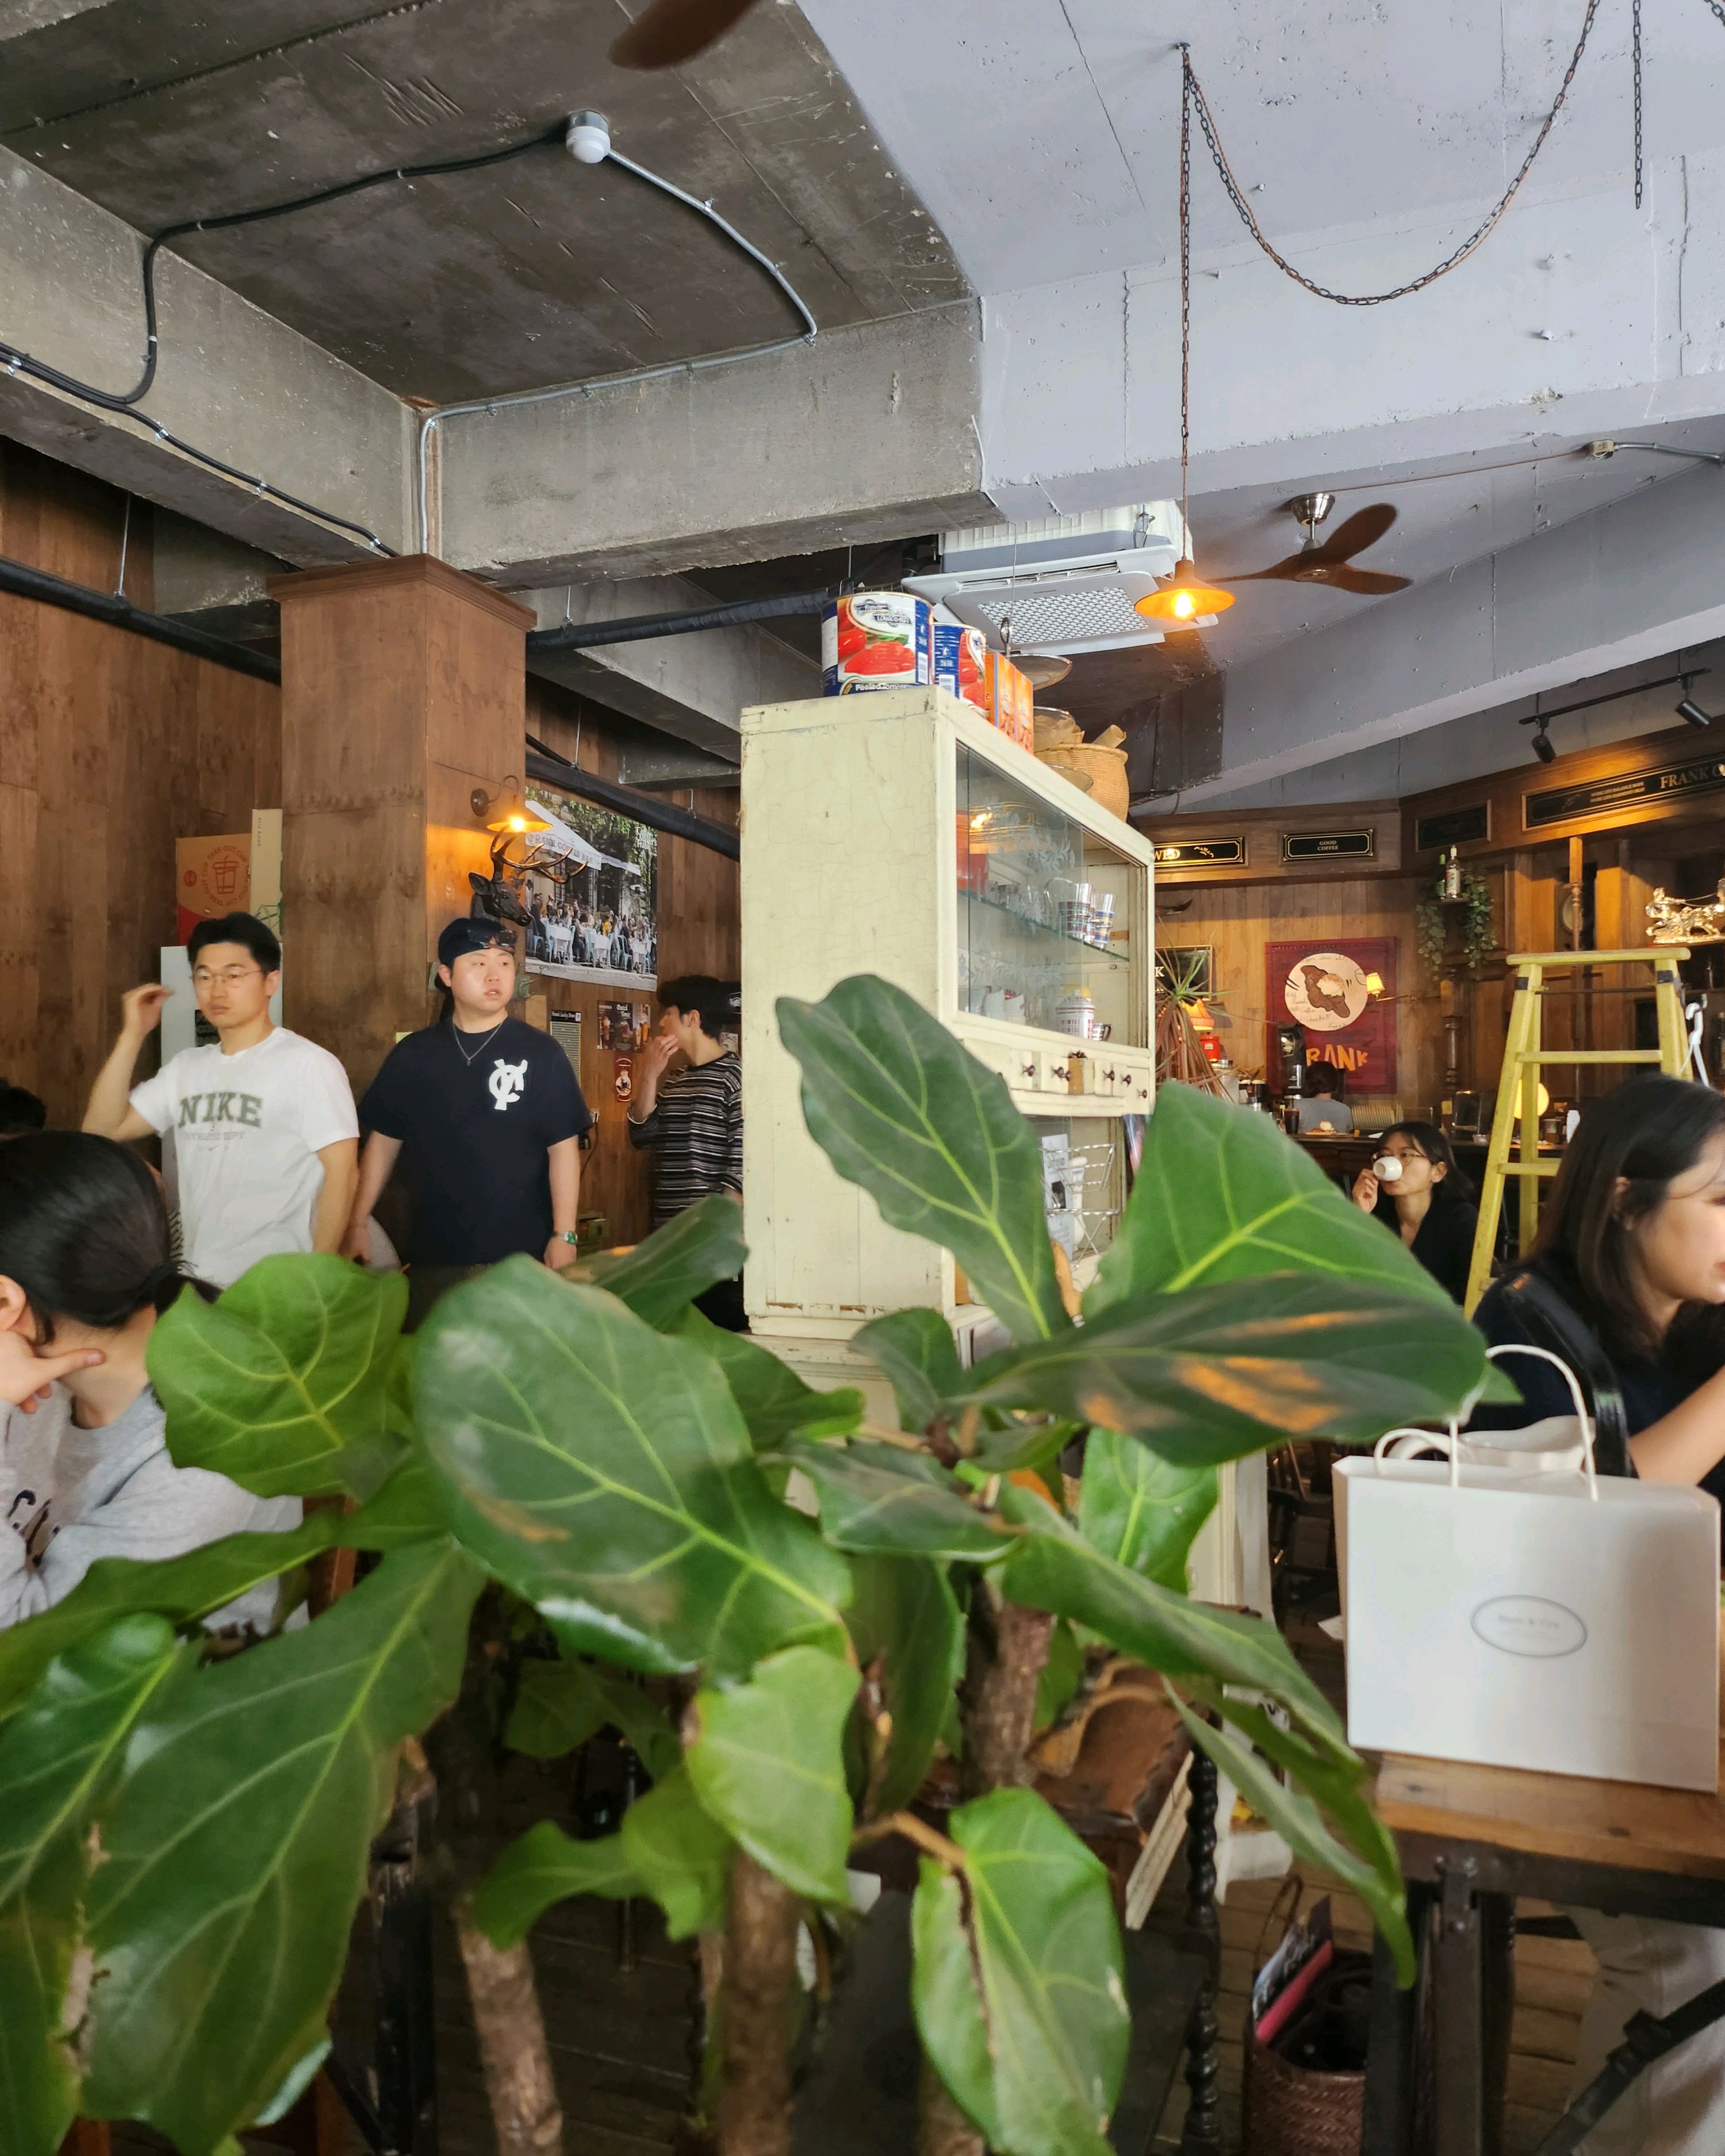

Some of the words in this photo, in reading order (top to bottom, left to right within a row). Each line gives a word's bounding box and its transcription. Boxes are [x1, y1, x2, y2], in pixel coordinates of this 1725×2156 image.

[1660, 766, 1709, 789] FRANK
[530, 834, 555, 848] FRANK
[558, 842, 580, 858] COFIN
[178, 1092, 262, 1128] NIKE
